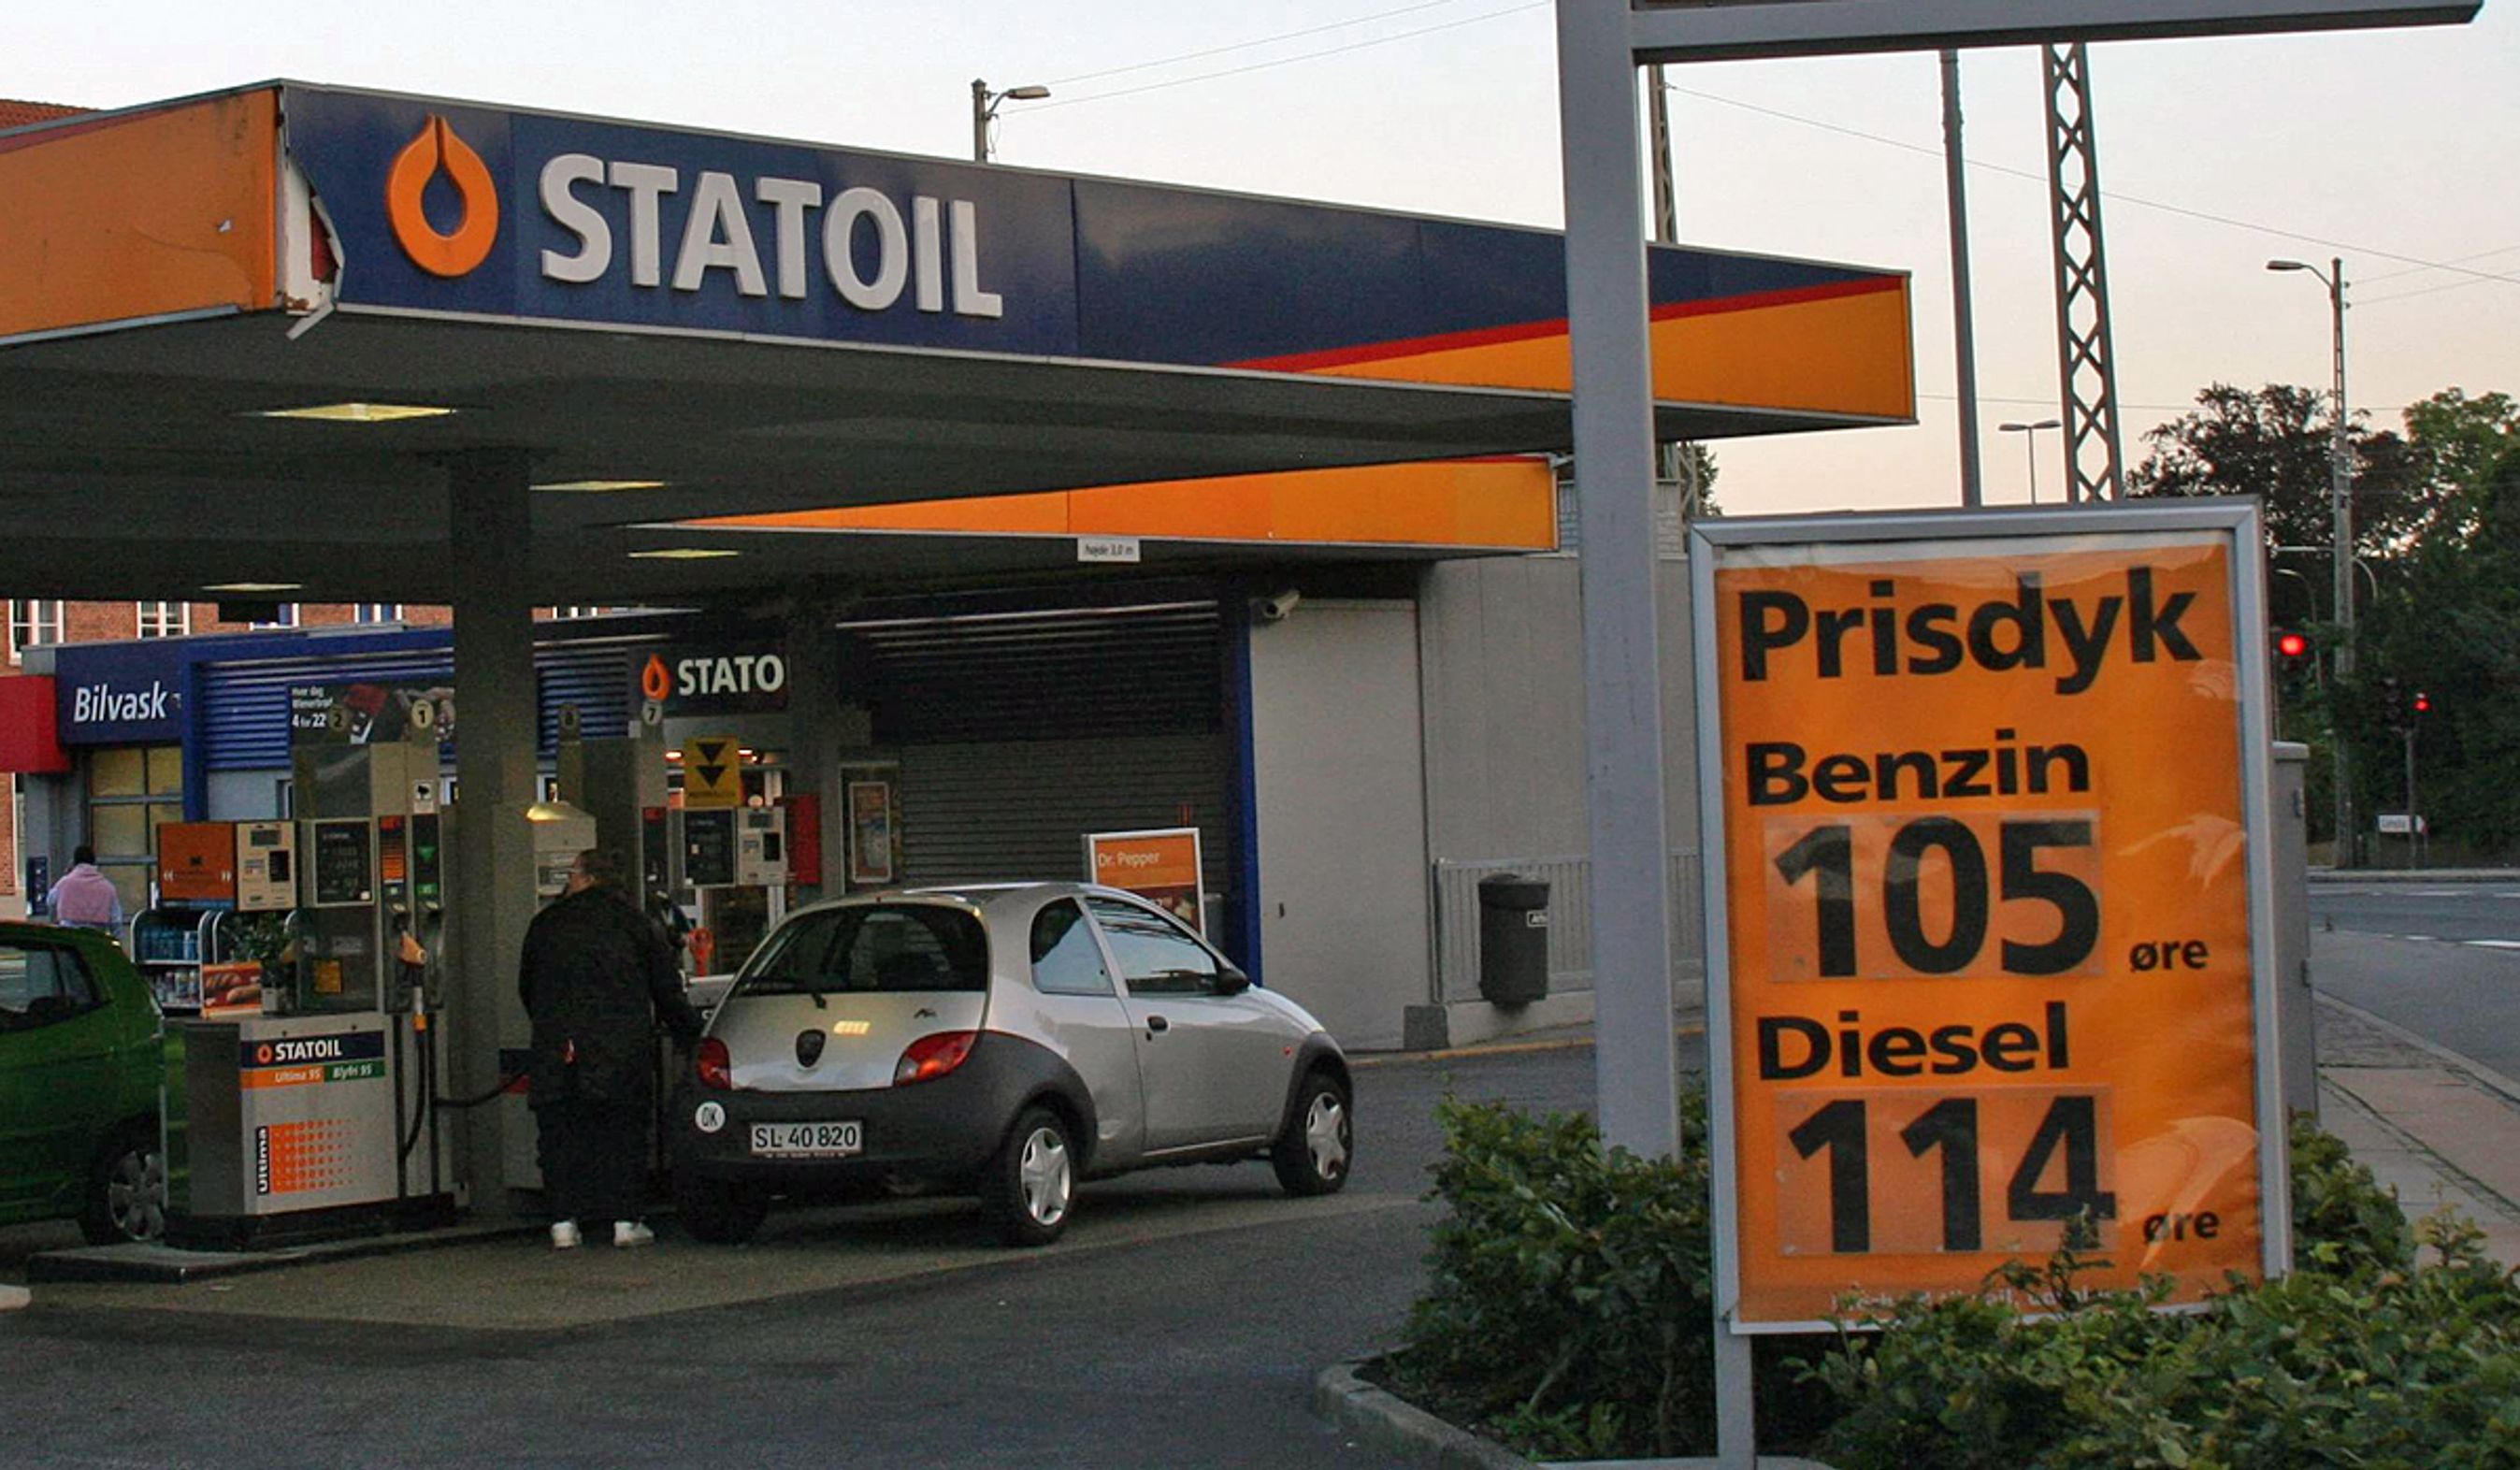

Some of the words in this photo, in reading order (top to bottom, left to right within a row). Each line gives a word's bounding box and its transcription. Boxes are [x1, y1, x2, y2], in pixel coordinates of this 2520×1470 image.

[539, 153, 1003, 318] STATOIL
[1740, 567, 2202, 696] Prisdyk
[74, 680, 168, 723] Bilvask
[678, 655, 785, 696] STATO
[312, 713, 326, 728] 22
[1747, 729, 2090, 805] Benzin
[1099, 852, 1115, 868] Dr.
[1117, 851, 1160, 868] Pepper
[1778, 817, 2100, 978] 105
[2131, 942, 2209, 972] øre
[275, 1039, 343, 1061] STATOIL
[1759, 1002, 2069, 1081] Diesel
[756, 1128, 784, 1148] SL
[788, 1127, 814, 1147] 40
[818, 1125, 857, 1147] 820
[1789, 1096, 2117, 1254] 114
[2143, 1212, 2221, 1244] øre
